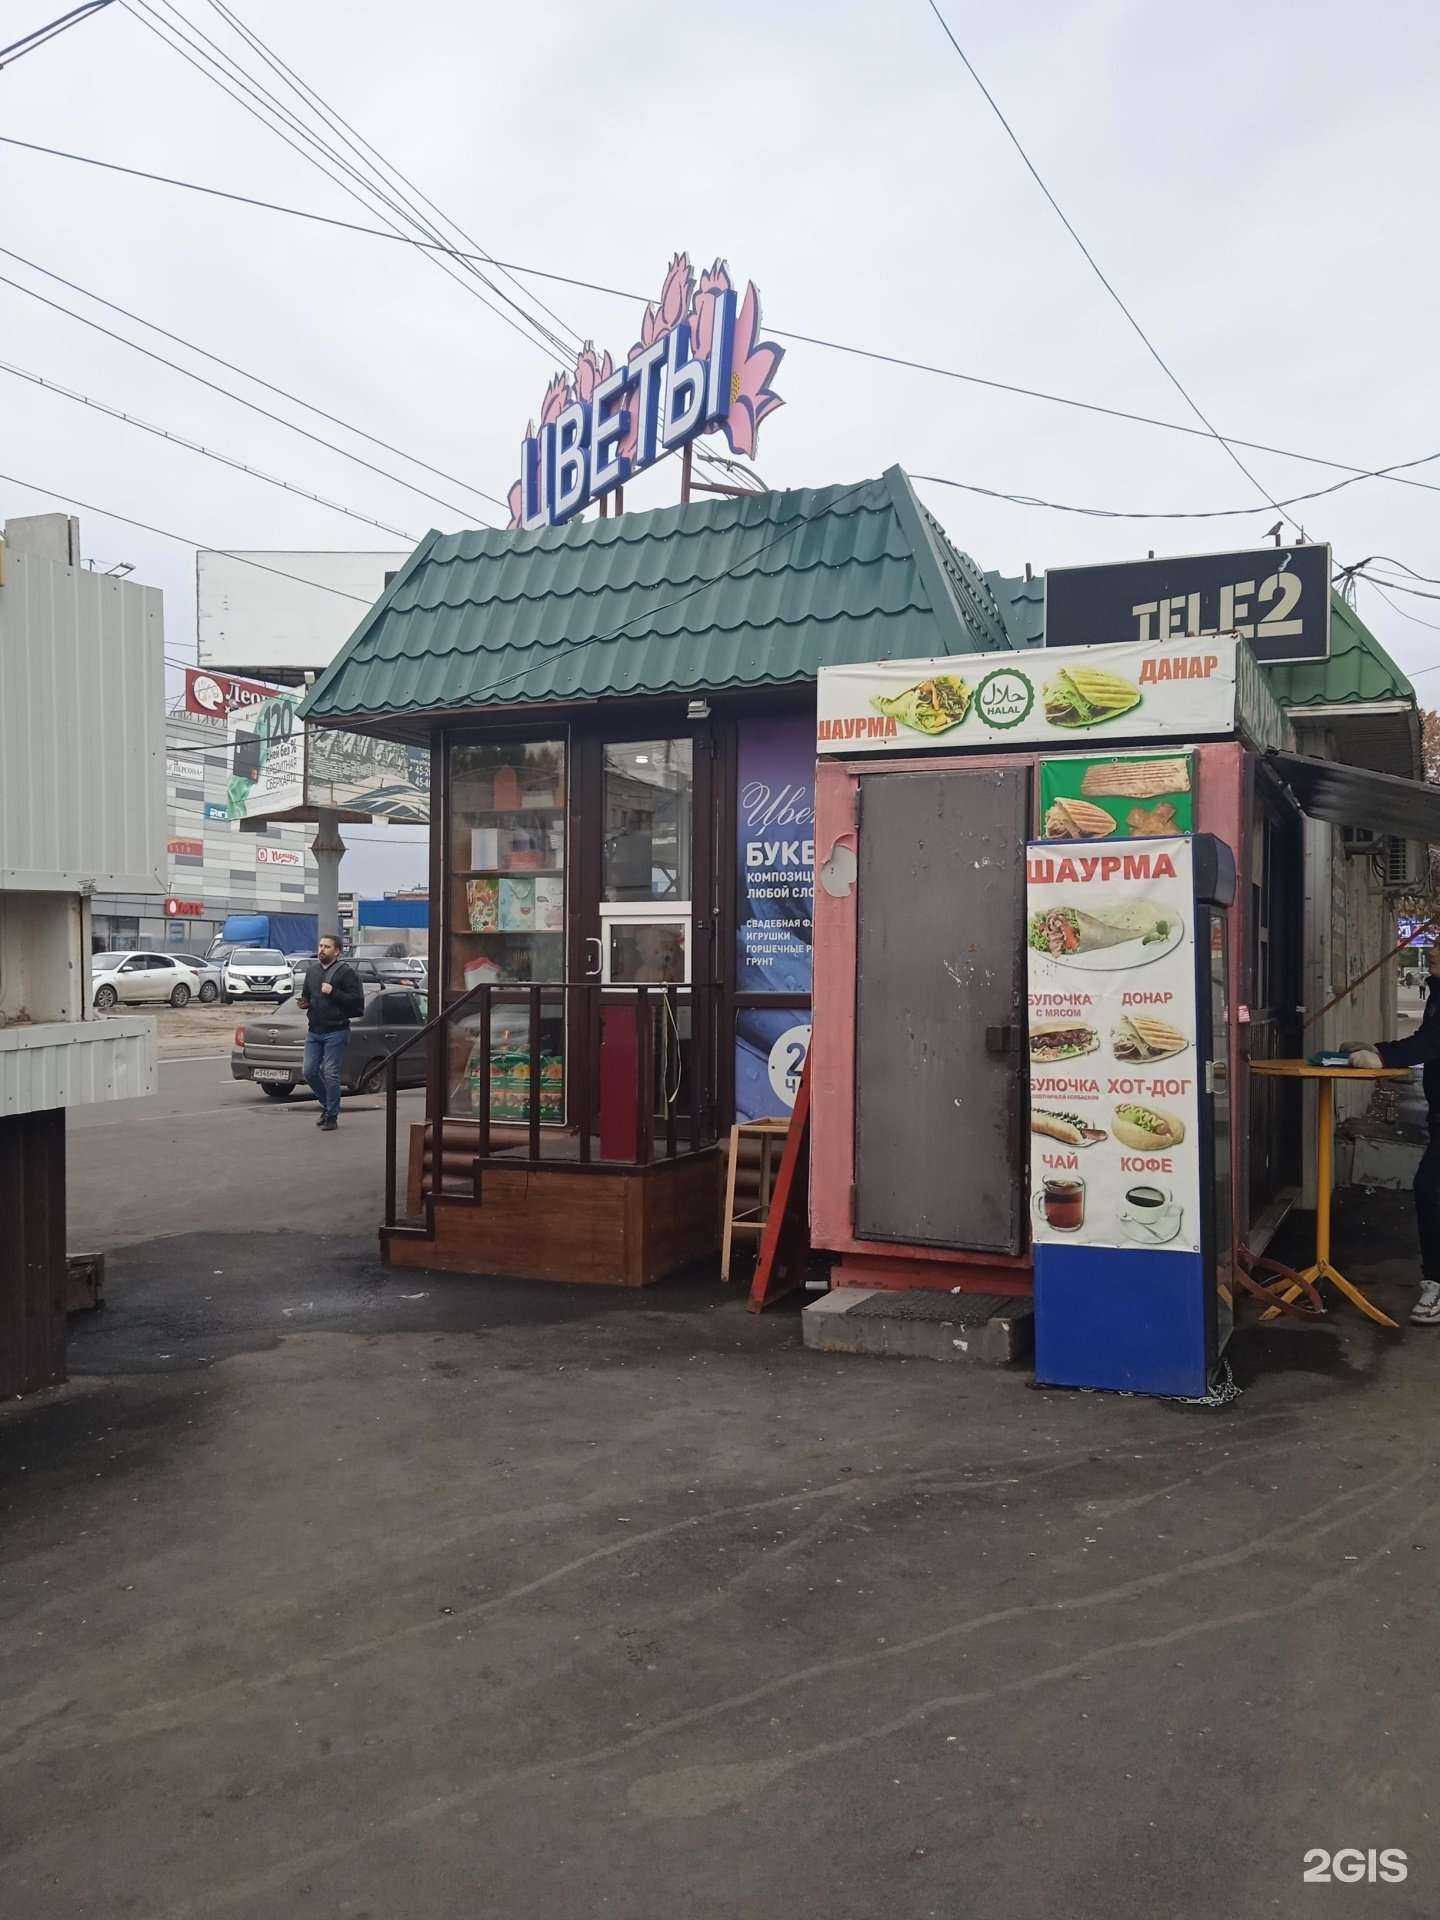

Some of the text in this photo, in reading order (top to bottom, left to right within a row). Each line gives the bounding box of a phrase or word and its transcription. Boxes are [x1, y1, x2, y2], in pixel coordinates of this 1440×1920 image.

[520, 288, 738, 529] ЦВЕТЫ
[1132, 572, 1303, 641] TELE2
[1139, 655, 1218, 685] ДАНАР
[225, 681, 267, 704] Лео
[982, 682, 1026, 706] حلال
[987, 705, 1021, 715] HALAL
[264, 700, 293, 748] 120
[818, 716, 898, 741] ШАУРМА
[746, 841, 815, 866] БУКЕ
[1027, 853, 1177, 884] ШАУРМА
[746, 885, 789, 898] ЛЮБОЙ
[746, 919, 800, 929] СВАДЕБНАЯ
[746, 932, 791, 941] ИГРУШКИ
[746, 945, 804, 953] ГОРШЕЧНЫЕ
[746, 957, 774, 966] ГРУНТ
[1028, 993, 1093, 1006] БУЛОЧКА
[1121, 992, 1173, 1006] ДОНАР
[1036, 1008, 1082, 1017] С МЯСОМ
[1030, 1078, 1100, 1093] БУЛОЧКА
[1107, 1078, 1192, 1097] ХОТ-ДОГ
[1042, 1152, 1079, 1169] ЧАЙ
[1120, 1157, 1173, 1173] КОФЕ
